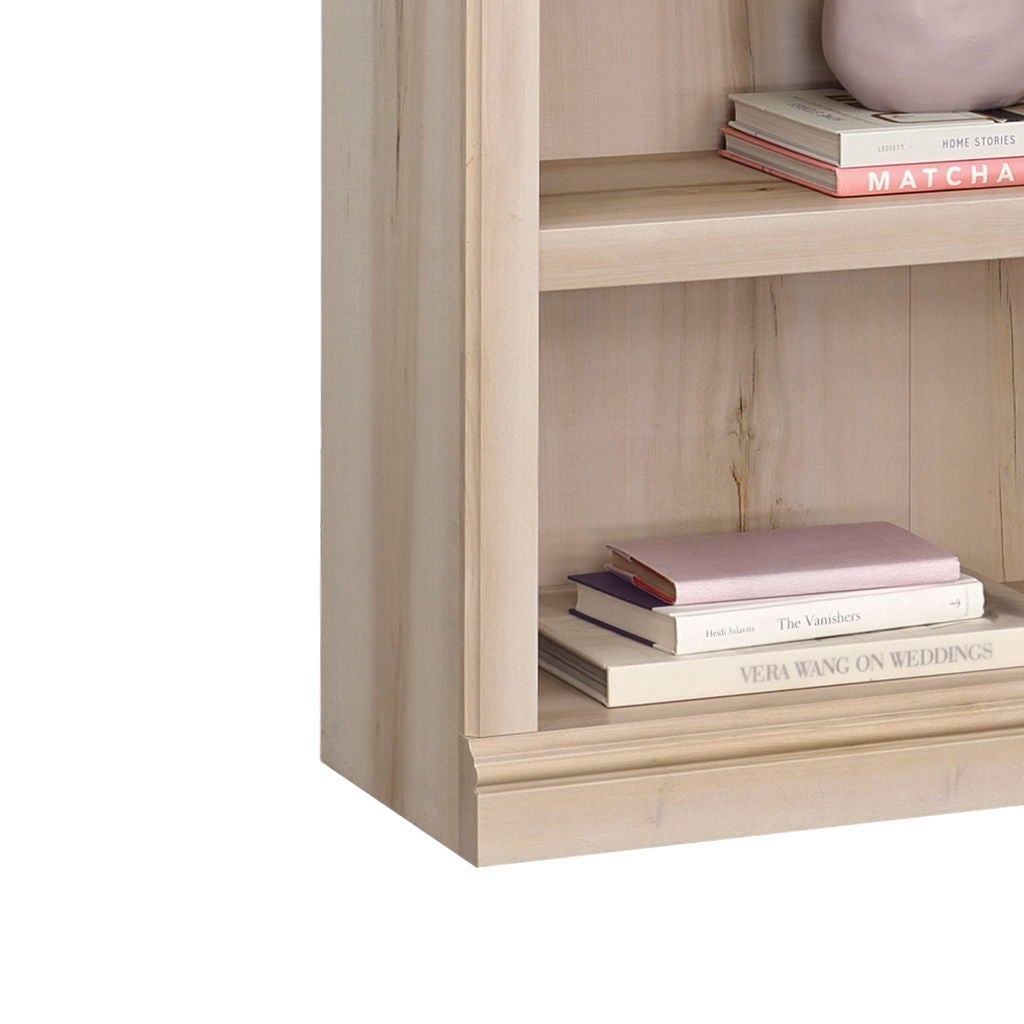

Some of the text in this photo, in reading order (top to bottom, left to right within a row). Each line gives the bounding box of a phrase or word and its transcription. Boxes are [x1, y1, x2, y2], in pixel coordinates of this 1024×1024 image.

[942, 135, 1016, 149] HOME STORIES
[868, 163, 1015, 192] MATCHA
[776, 610, 862, 631] The Vanishers
[705, 628, 727, 638] Heidi
[740, 642, 993, 683] VERA WANG ON WEDDINGS
